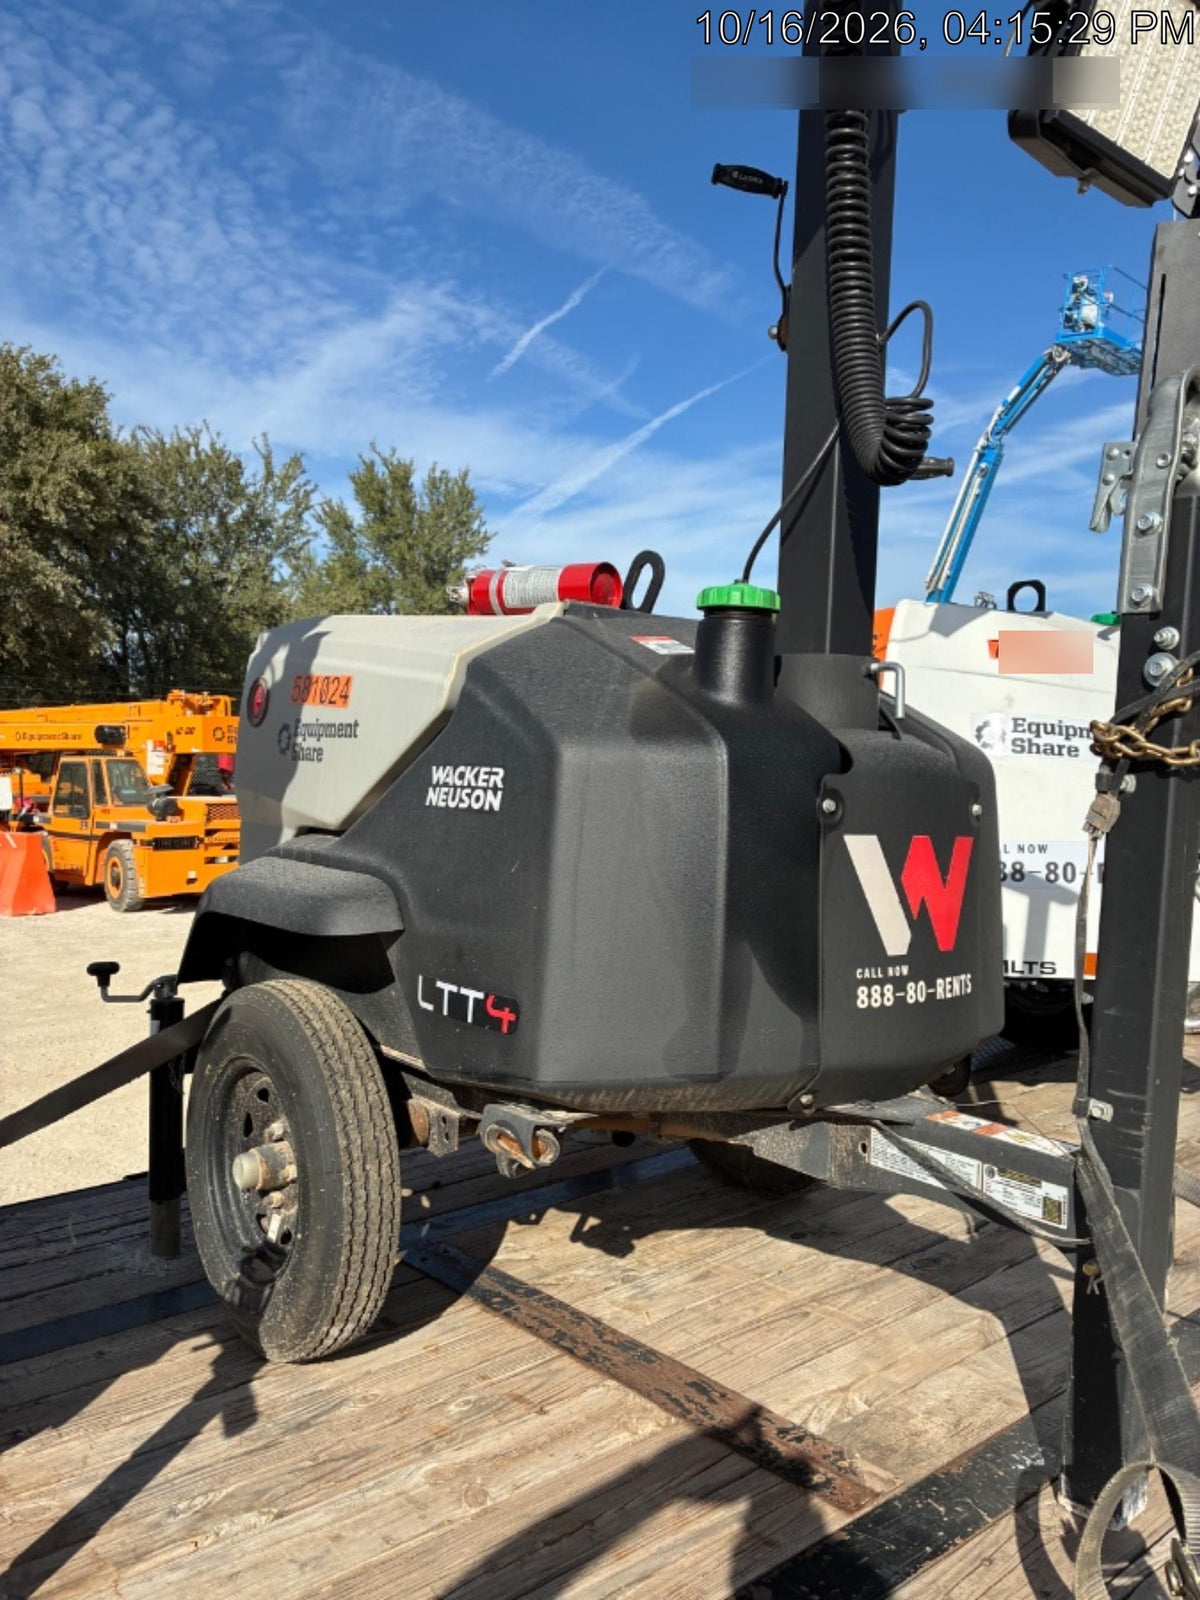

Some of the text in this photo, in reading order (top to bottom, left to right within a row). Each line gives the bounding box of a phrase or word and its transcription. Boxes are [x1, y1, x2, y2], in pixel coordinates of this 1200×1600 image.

[294, 718, 359, 742] Equipment
[292, 743, 324, 762] Share
[1010, 737, 1080, 758] Share
[431, 765, 505, 789] WACKER
[425, 786, 503, 812] NEUSON
[1017, 843, 1049, 855] NOW
[856, 964, 909, 979] CALL NOW
[856, 973, 972, 1009] 888-80-RENTS
[418, 975, 516, 1033] LTT4
